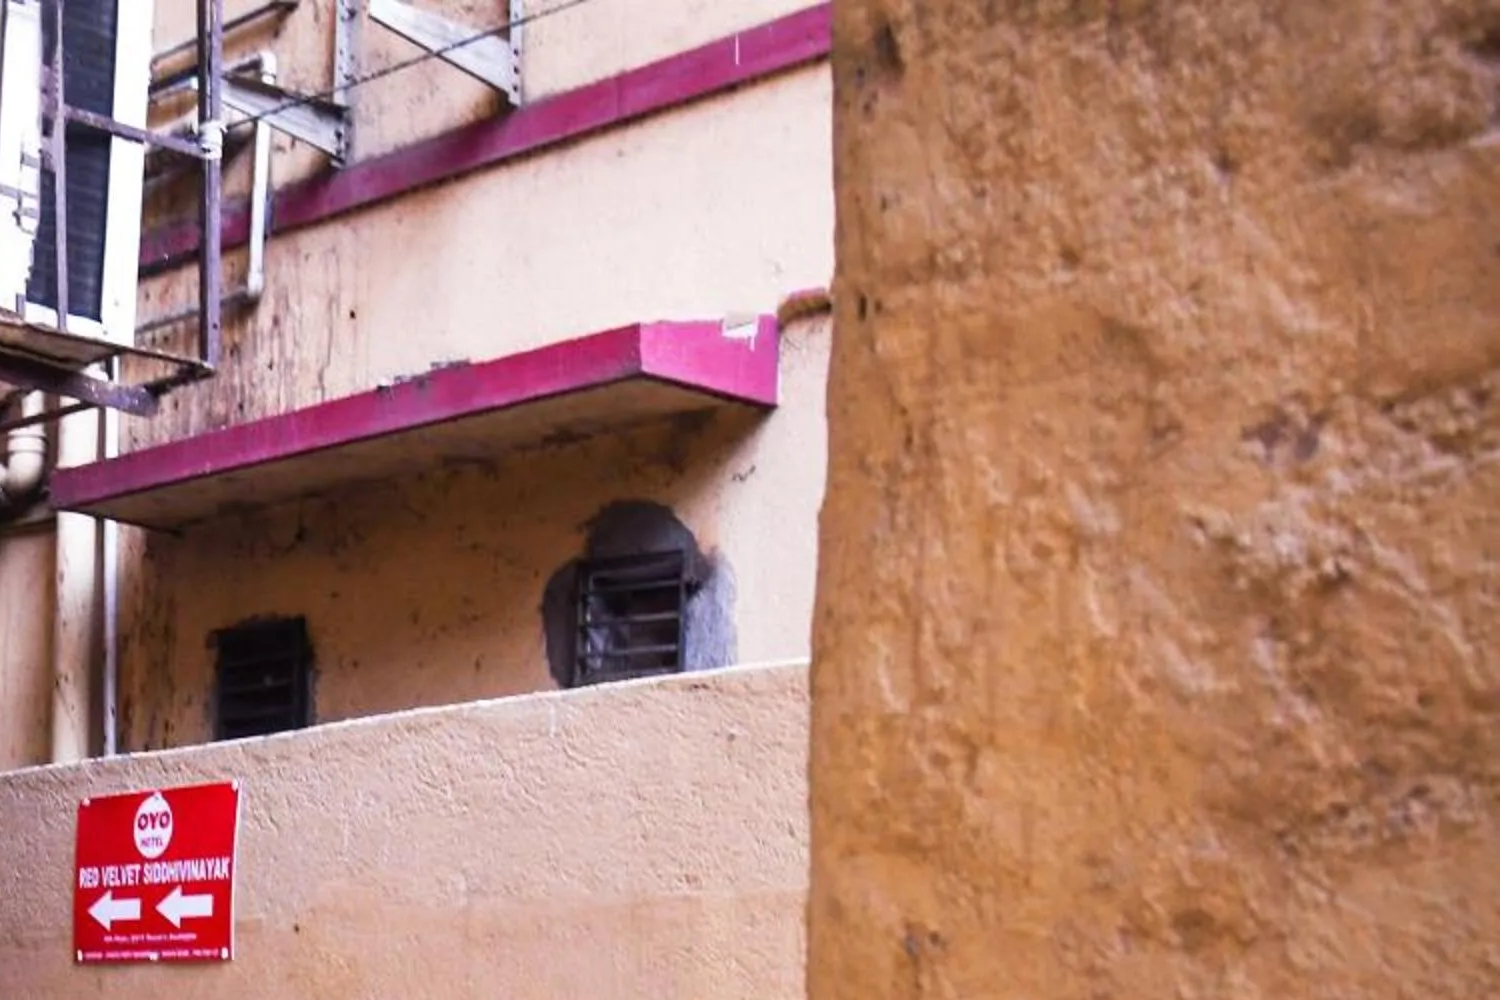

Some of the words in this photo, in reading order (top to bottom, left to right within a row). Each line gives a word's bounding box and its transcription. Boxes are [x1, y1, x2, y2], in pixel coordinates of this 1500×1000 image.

[137, 811, 171, 831] OYO
[79, 866, 100, 889] RED
[101, 863, 141, 888] VELVET
